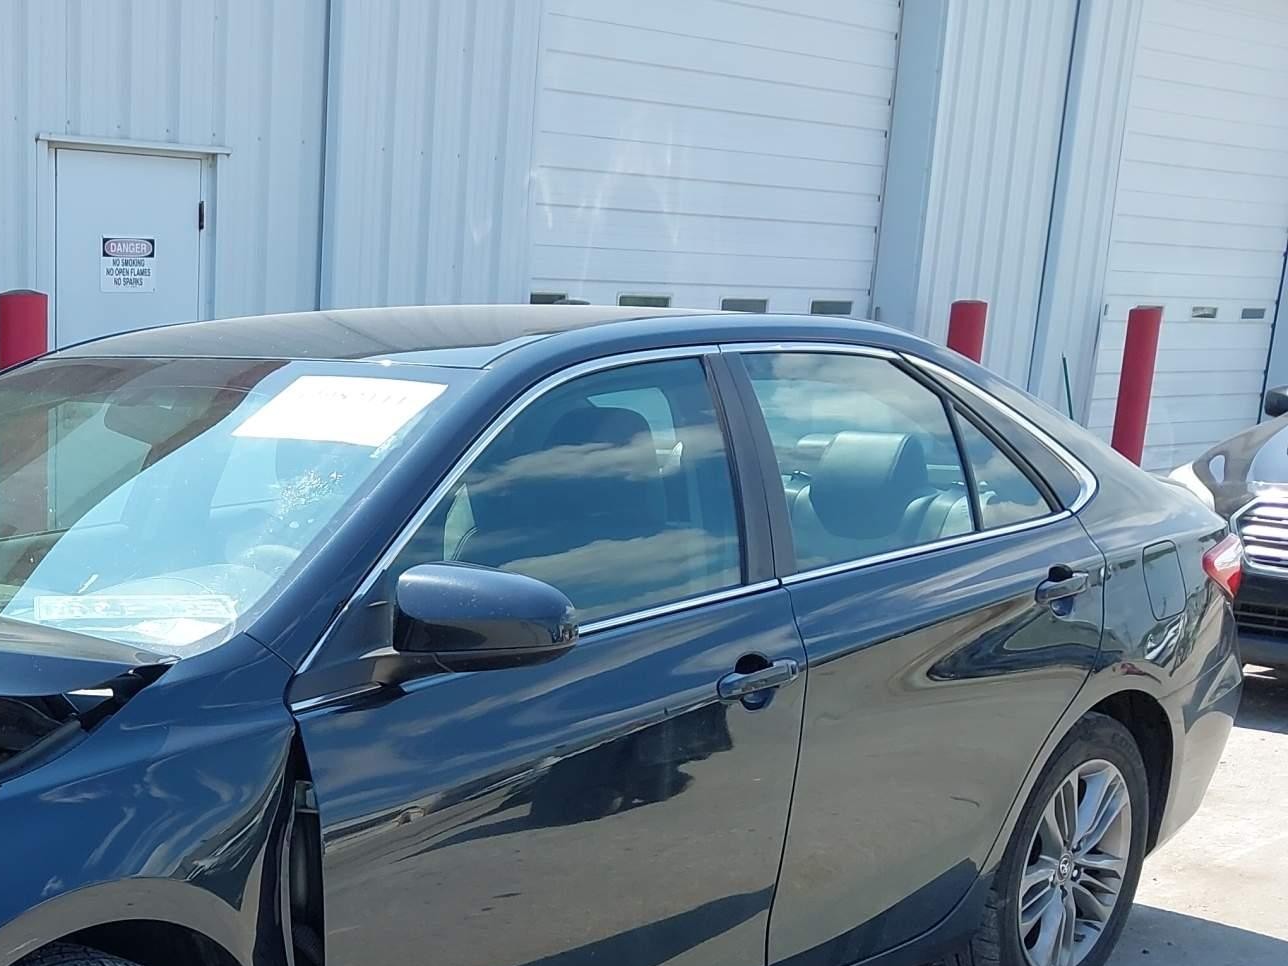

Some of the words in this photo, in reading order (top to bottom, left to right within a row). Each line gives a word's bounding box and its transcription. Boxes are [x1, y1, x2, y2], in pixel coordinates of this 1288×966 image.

[111, 242, 146, 253] DANGER
[113, 259, 120, 267] NO
[121, 259, 145, 267] SMOKING
[106, 268, 114, 276] NO
[115, 268, 129, 276] OPEN
[131, 268, 151, 277] FLAMES
[114, 278, 122, 286] NO
[123, 278, 143, 287] SPARKS
